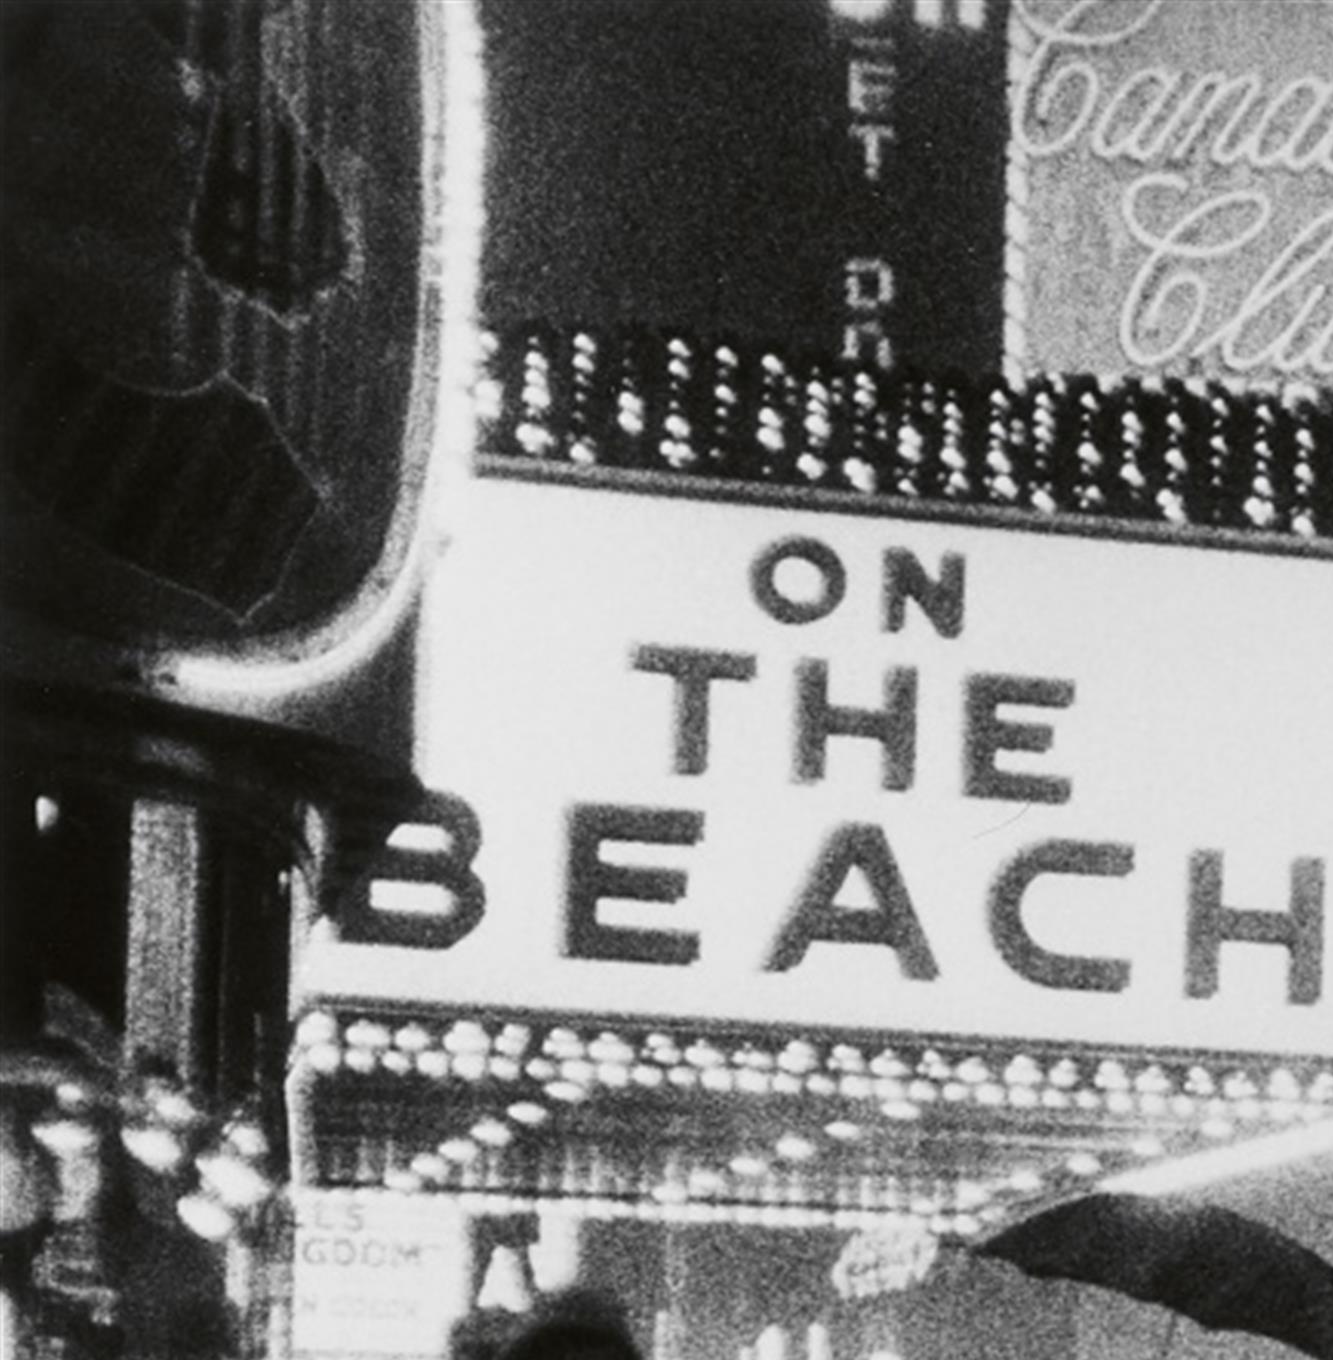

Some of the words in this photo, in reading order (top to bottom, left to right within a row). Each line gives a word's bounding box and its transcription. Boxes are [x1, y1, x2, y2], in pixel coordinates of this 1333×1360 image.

[749, 533, 966, 640] ON
[629, 642, 1077, 806] THE
[328, 787, 1326, 1006] BEACH
